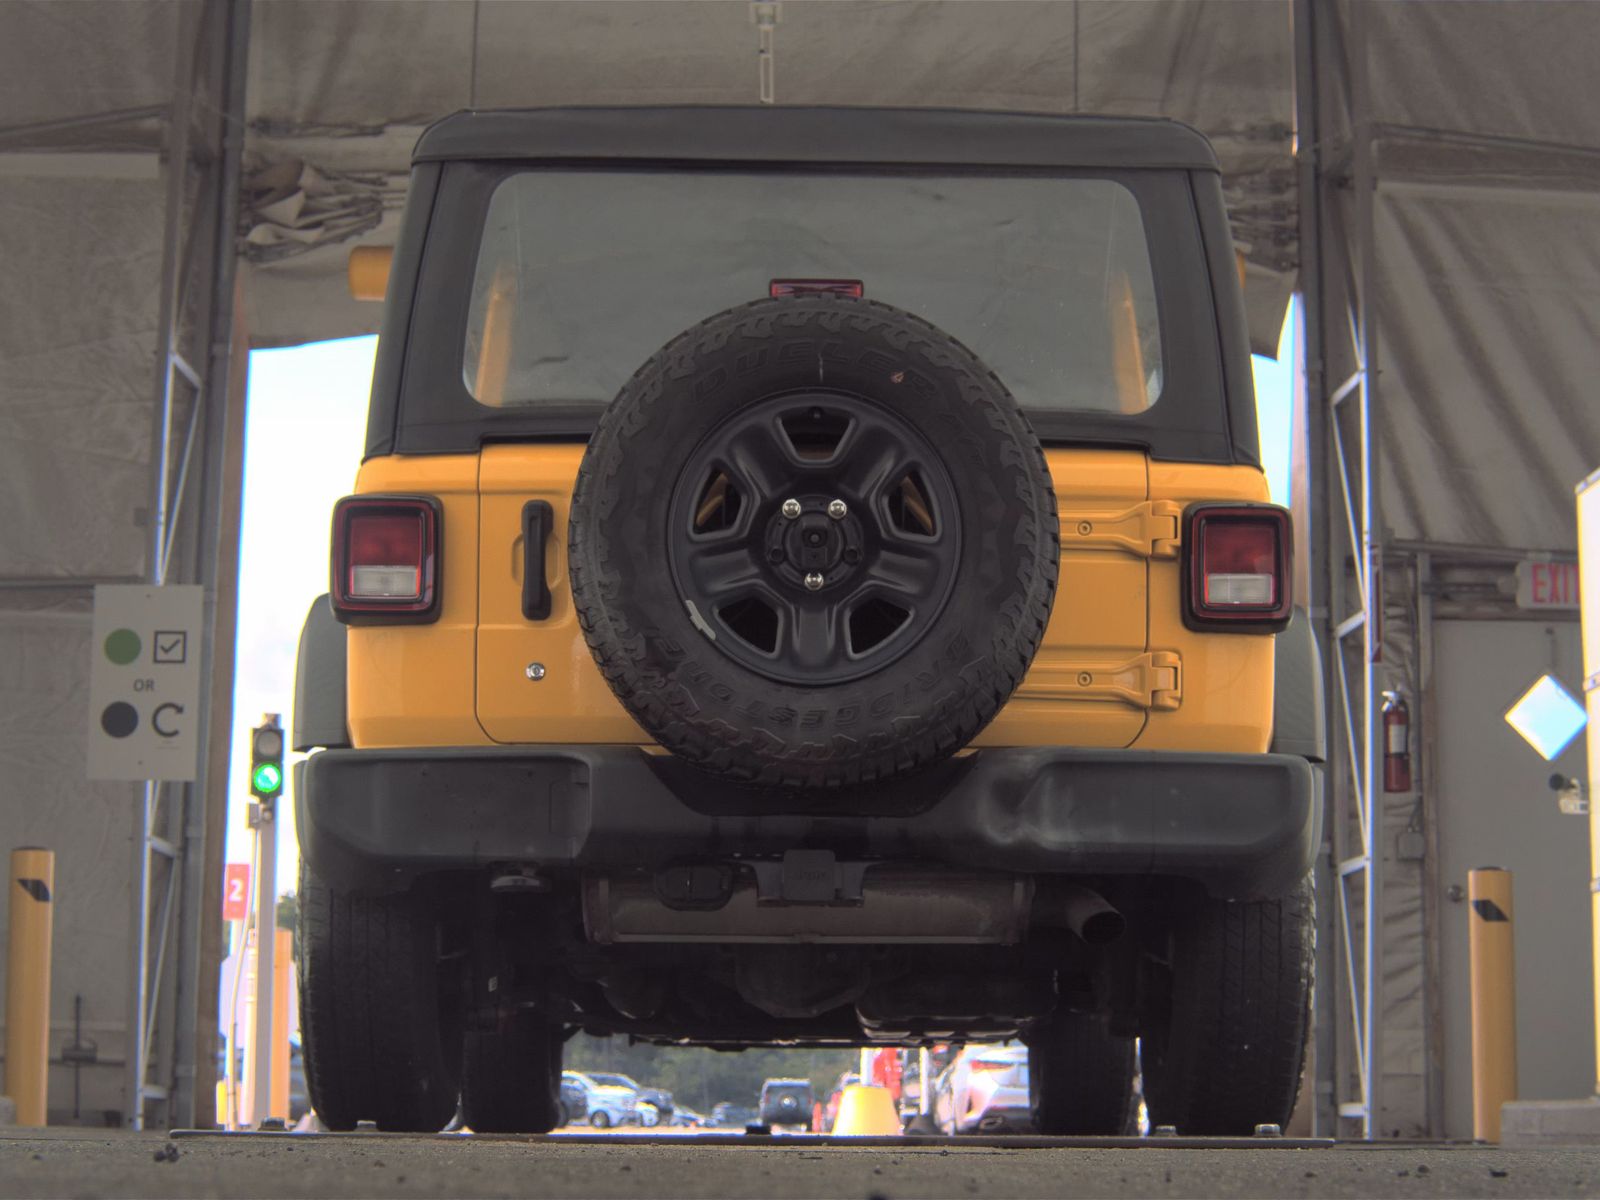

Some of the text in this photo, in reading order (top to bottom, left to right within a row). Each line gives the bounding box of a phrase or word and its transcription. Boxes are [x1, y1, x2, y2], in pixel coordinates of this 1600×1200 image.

[688, 337, 940, 404] DUELER
[133, 677, 156, 693] OR
[228, 877, 245, 903] 2
